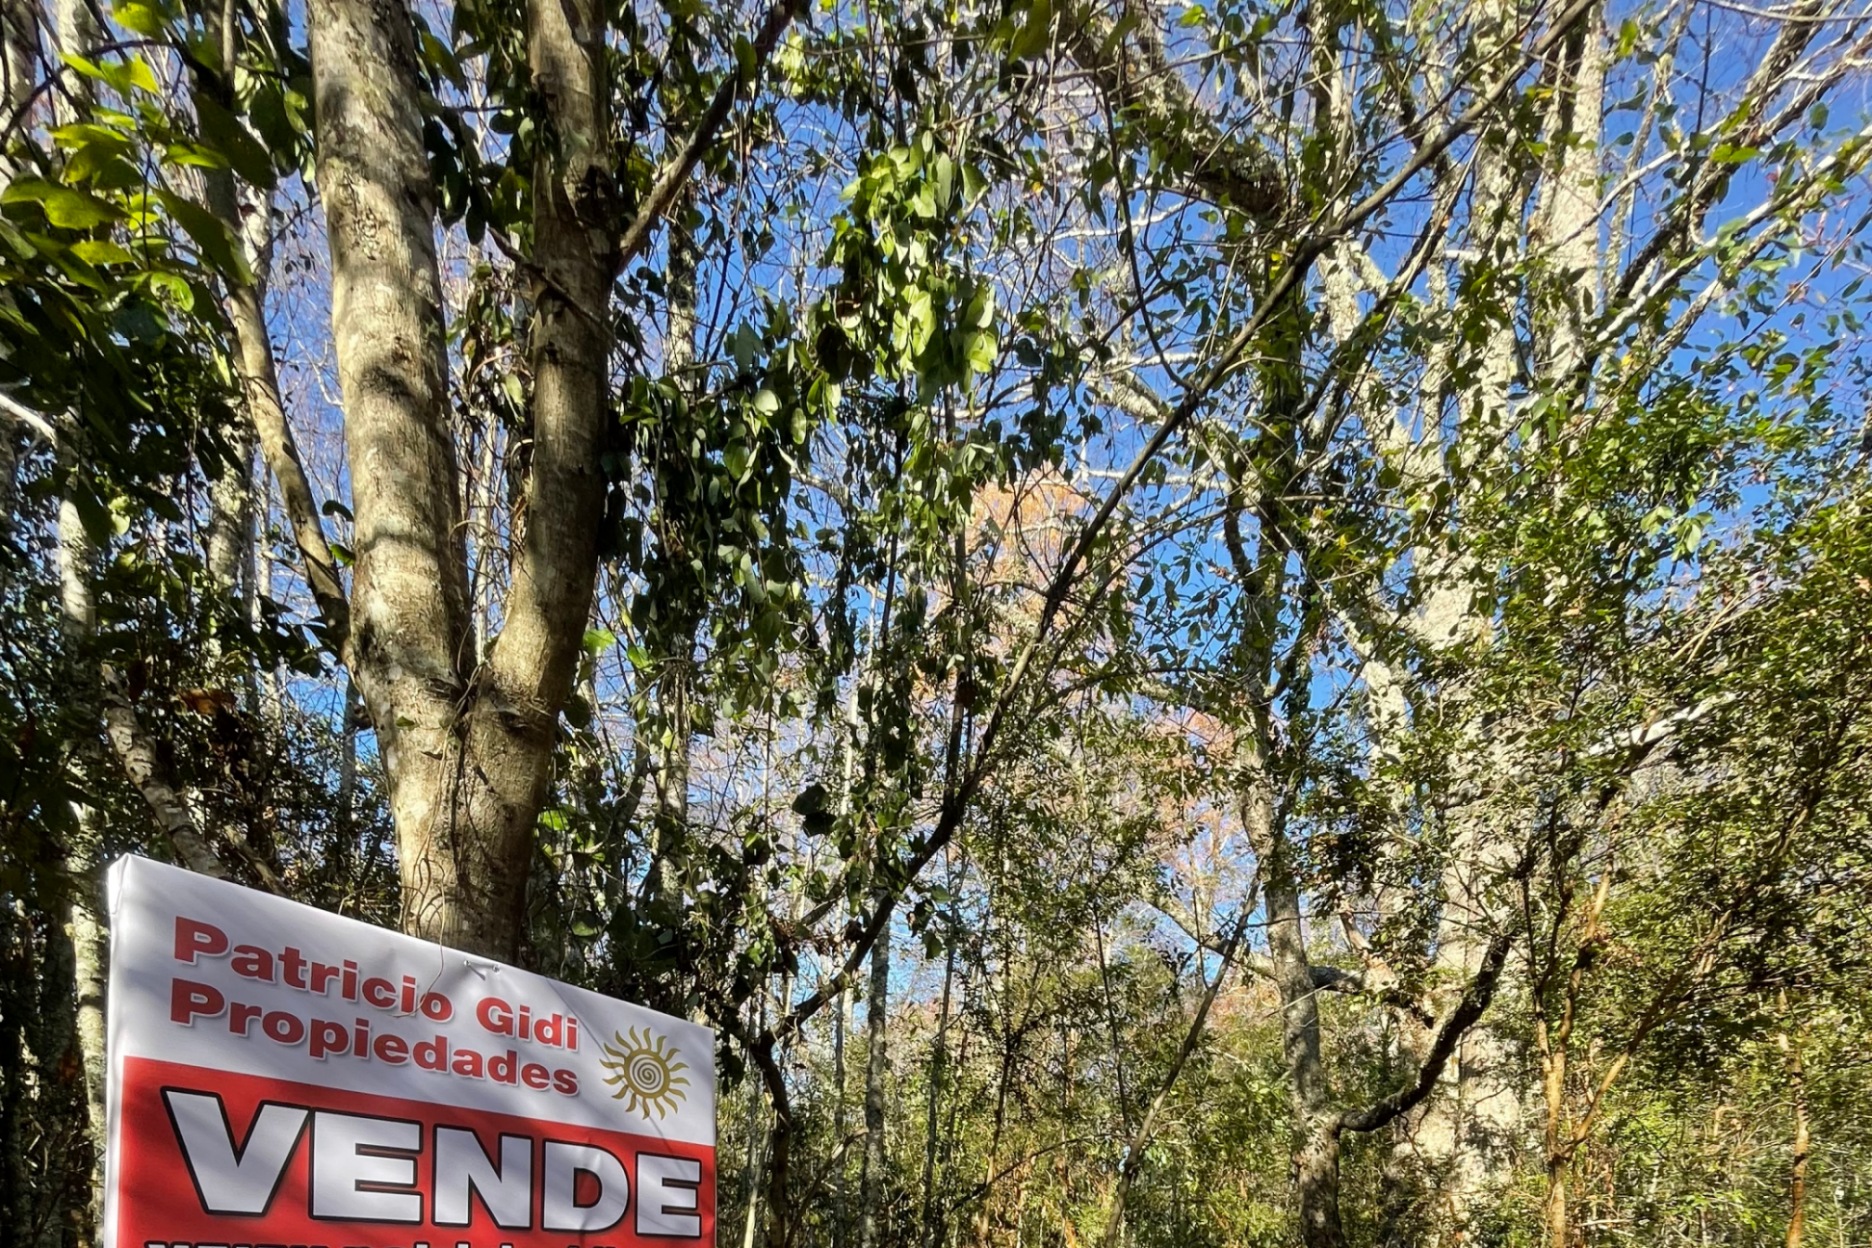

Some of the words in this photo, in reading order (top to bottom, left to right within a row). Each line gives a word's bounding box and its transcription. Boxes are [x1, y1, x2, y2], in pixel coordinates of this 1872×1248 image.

[169, 977, 580, 1096] Propiedades
[174, 915, 453, 1023] Patricio
[476, 996, 580, 1051] Gidi
[161, 1088, 702, 1237] VENDE
